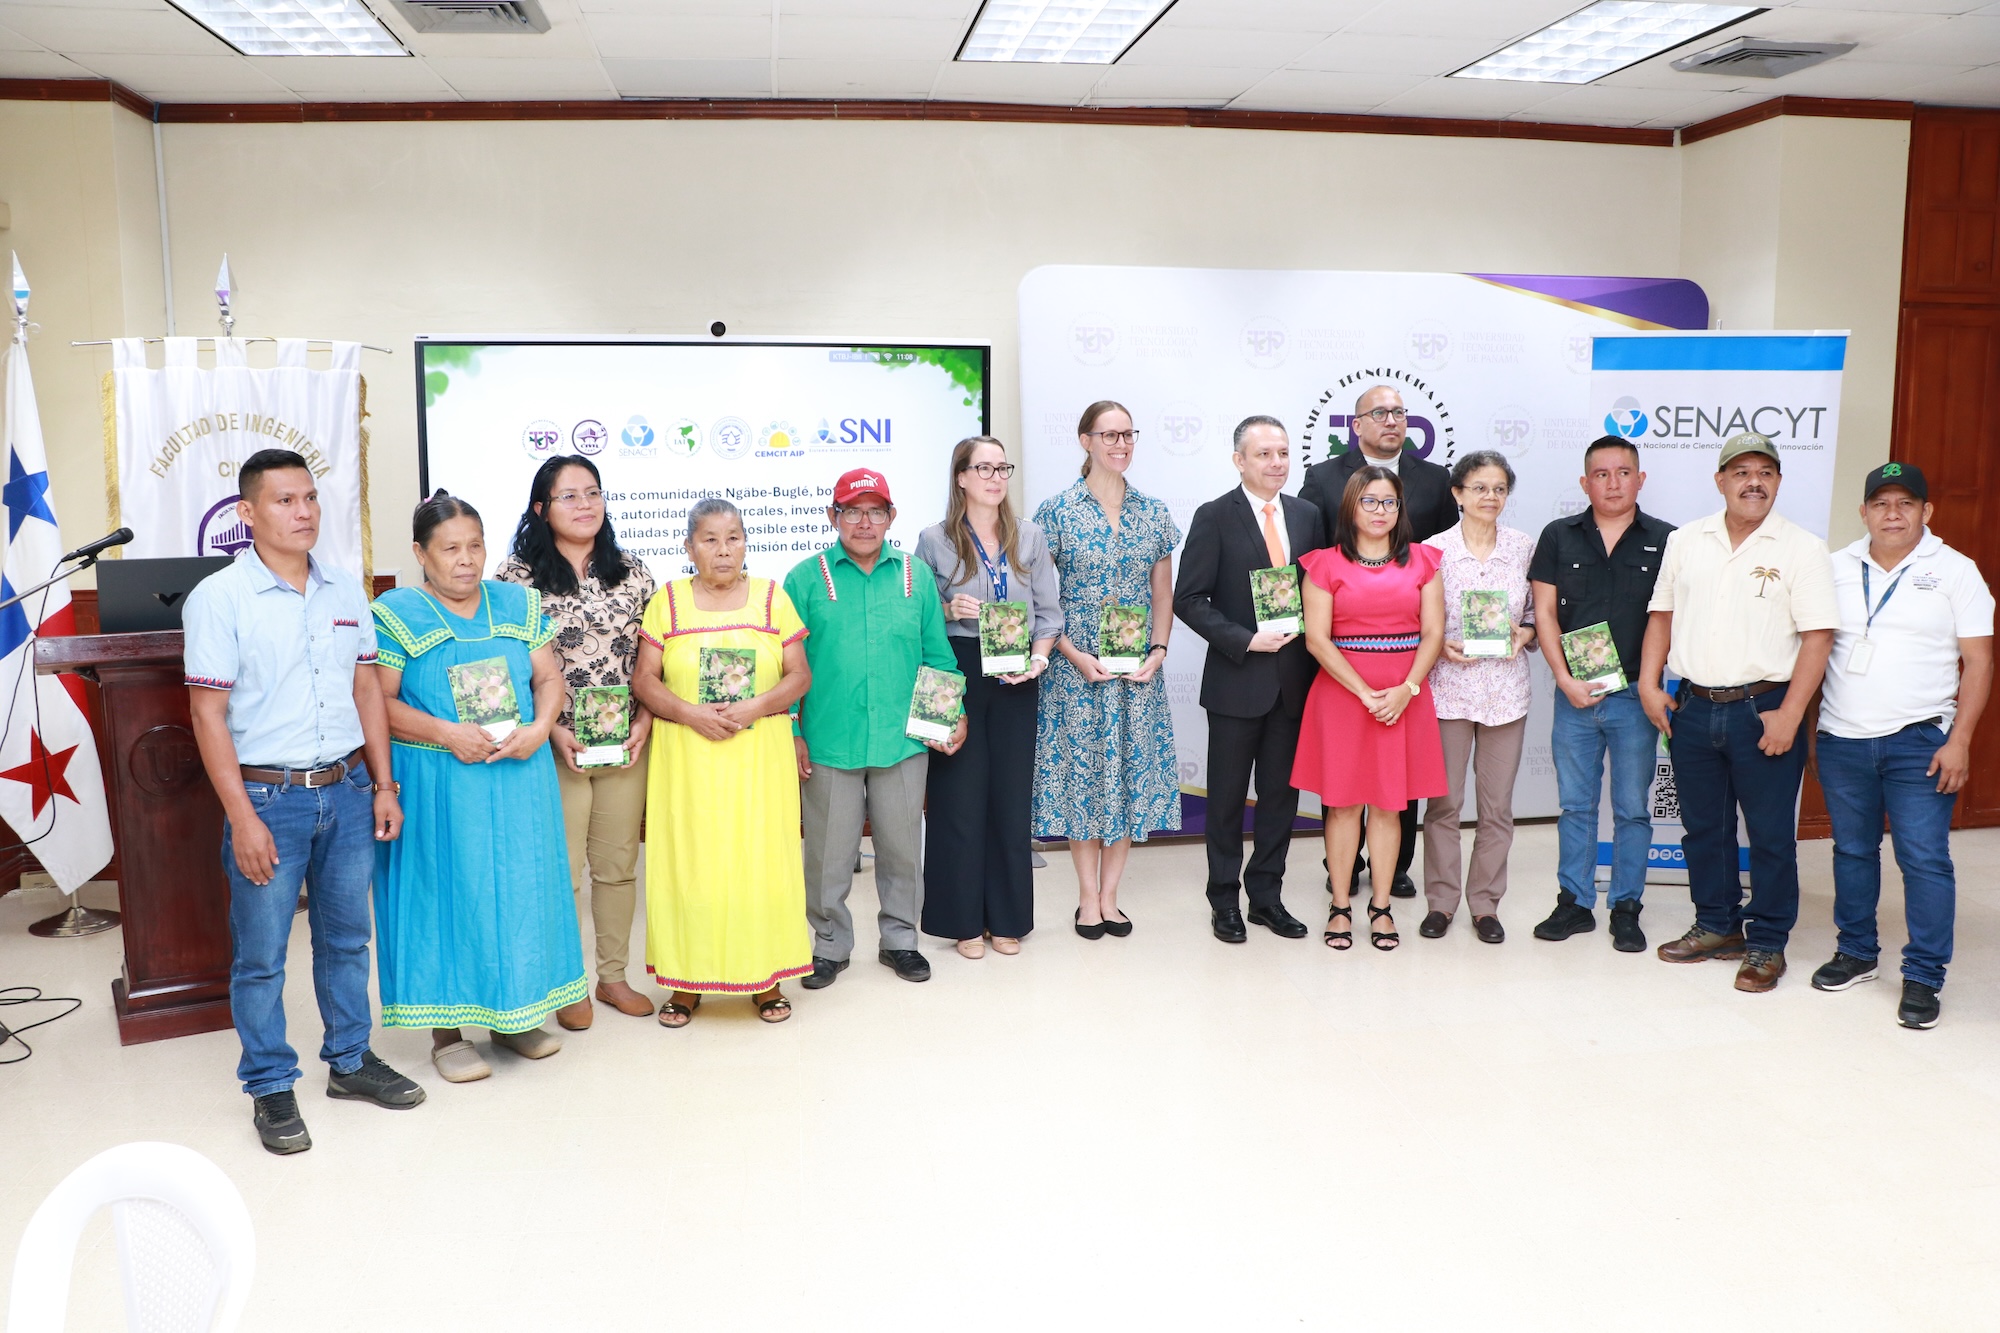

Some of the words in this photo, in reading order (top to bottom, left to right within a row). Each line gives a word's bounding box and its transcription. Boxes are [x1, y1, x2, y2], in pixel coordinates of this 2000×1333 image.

[1130, 325, 1199, 336] UNIVERSIDAD
[1300, 328, 1366, 339] UNIVERSIDAD
[1462, 332, 1525, 343] UNIVERSIDAD
[1336, 367, 1434, 401] TECNOLOGICA
[1434, 401, 1451, 423] DE
[1652, 405, 1828, 439] SENACYT
[839, 418, 891, 444] SNI
[149, 417, 212, 479] FACULTAD
[215, 413, 239, 432] DE
[245, 413, 331, 480] INGENIERIA
[618, 447, 658, 457] SENACYT
[1680, 442, 1691, 450] de
[754, 450, 788, 458] CEMCIT
[789, 450, 805, 458] AIP
[1882, 462, 1902, 479] B
[849, 479, 875, 490] PUMA
[630, 488, 722, 501] comunidades
[726, 485, 813, 501] Ngäbe-Buglé,
[620, 527, 669, 538] aliadas
[790, 523, 818, 533] este
[791, 540, 812, 552] del
